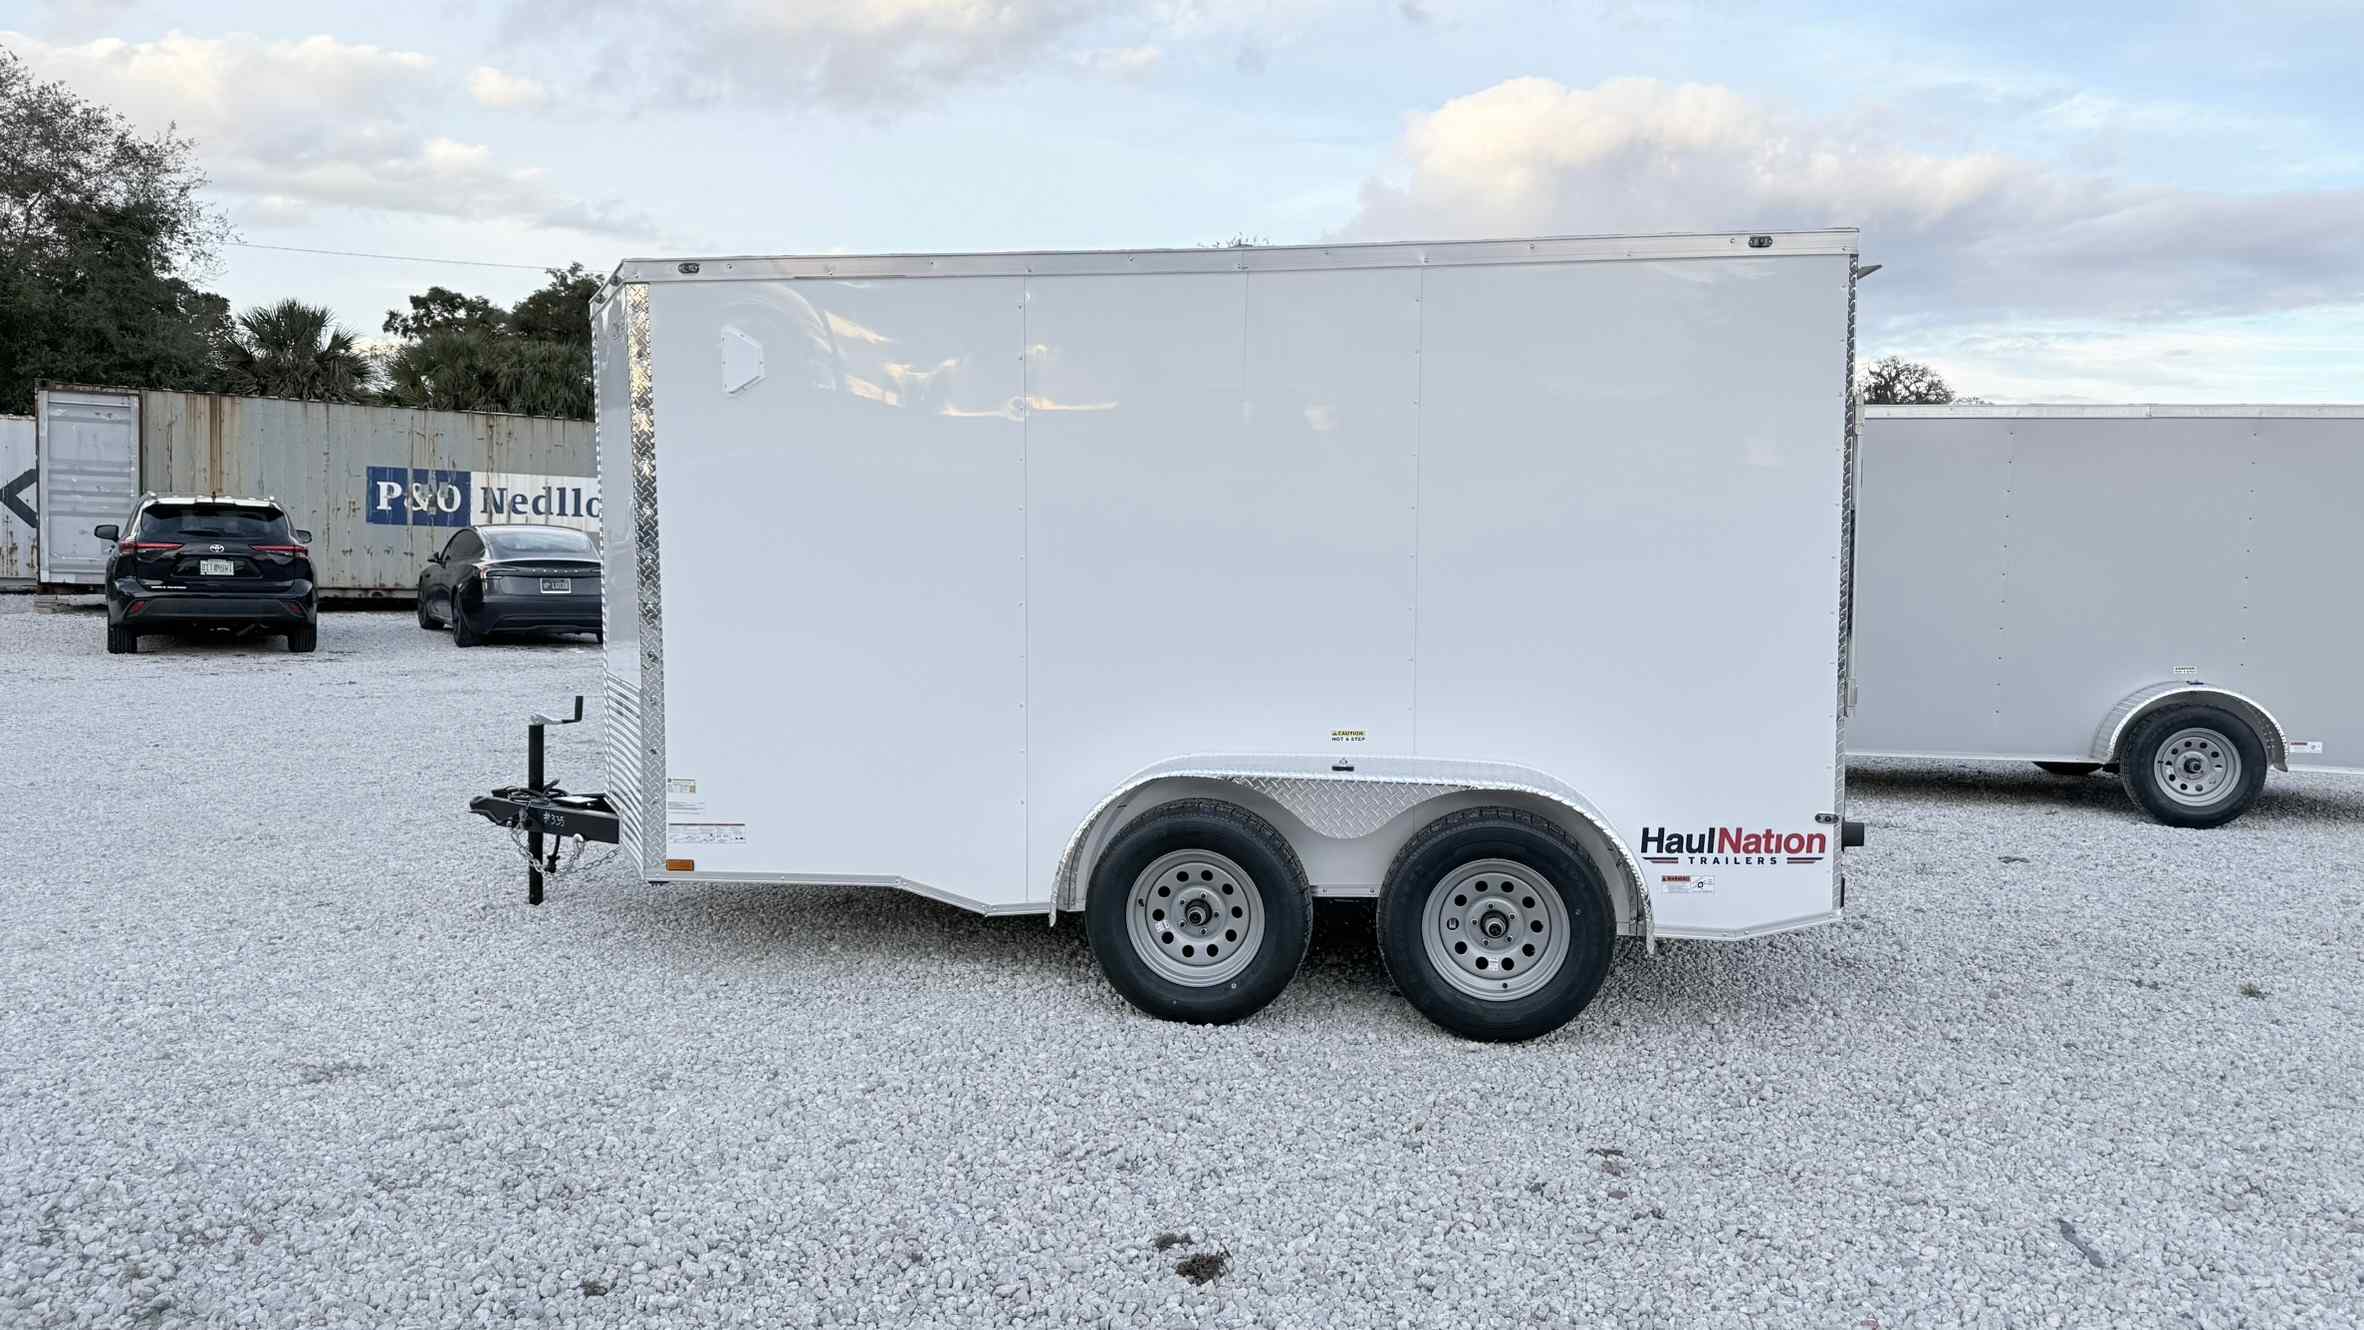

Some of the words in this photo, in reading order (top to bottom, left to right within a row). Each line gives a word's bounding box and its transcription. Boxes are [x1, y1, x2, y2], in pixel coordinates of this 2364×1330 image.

[376, 480, 463, 513] P&O
[1640, 827, 1827, 855] HaulNation
[1687, 856, 1778, 866] TRAILERS
